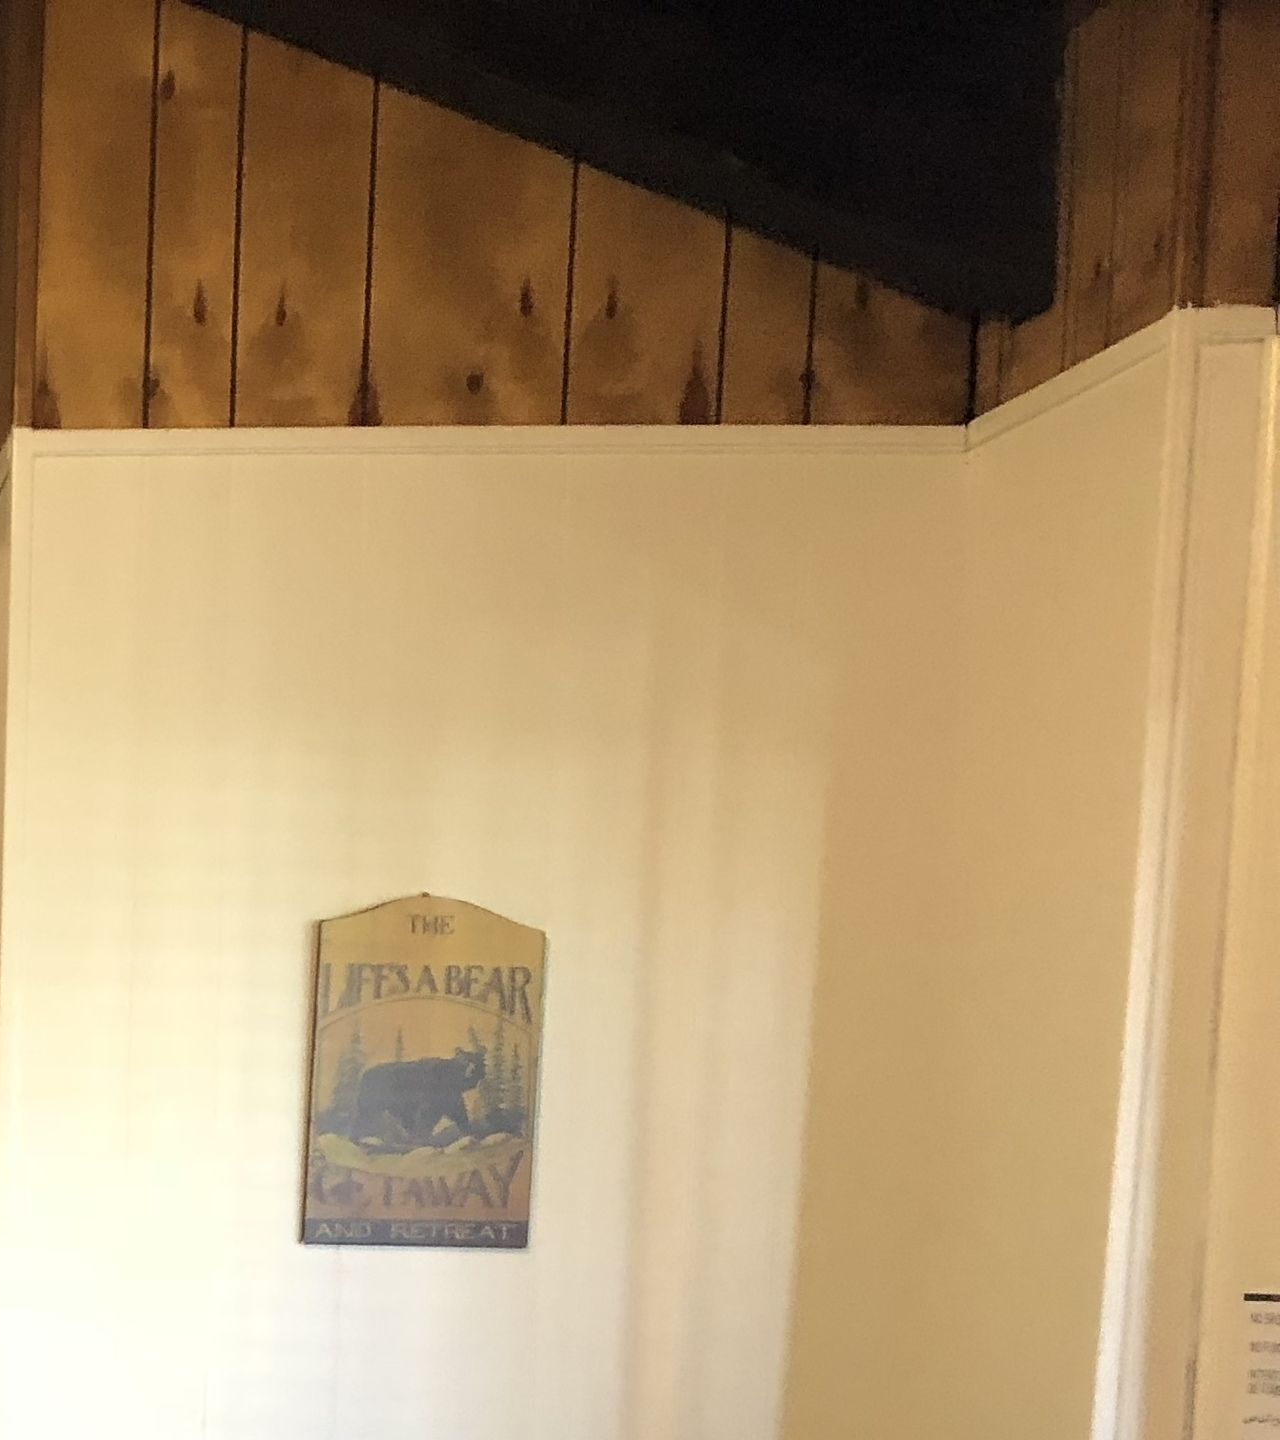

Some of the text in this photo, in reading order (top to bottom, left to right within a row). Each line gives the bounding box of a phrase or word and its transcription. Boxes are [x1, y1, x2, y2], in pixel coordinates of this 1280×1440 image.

[407, 914, 456, 936] THE
[414, 964, 439, 994] A
[443, 963, 534, 1024] BEAR
[313, 1222, 521, 1241] AND RETREAT
